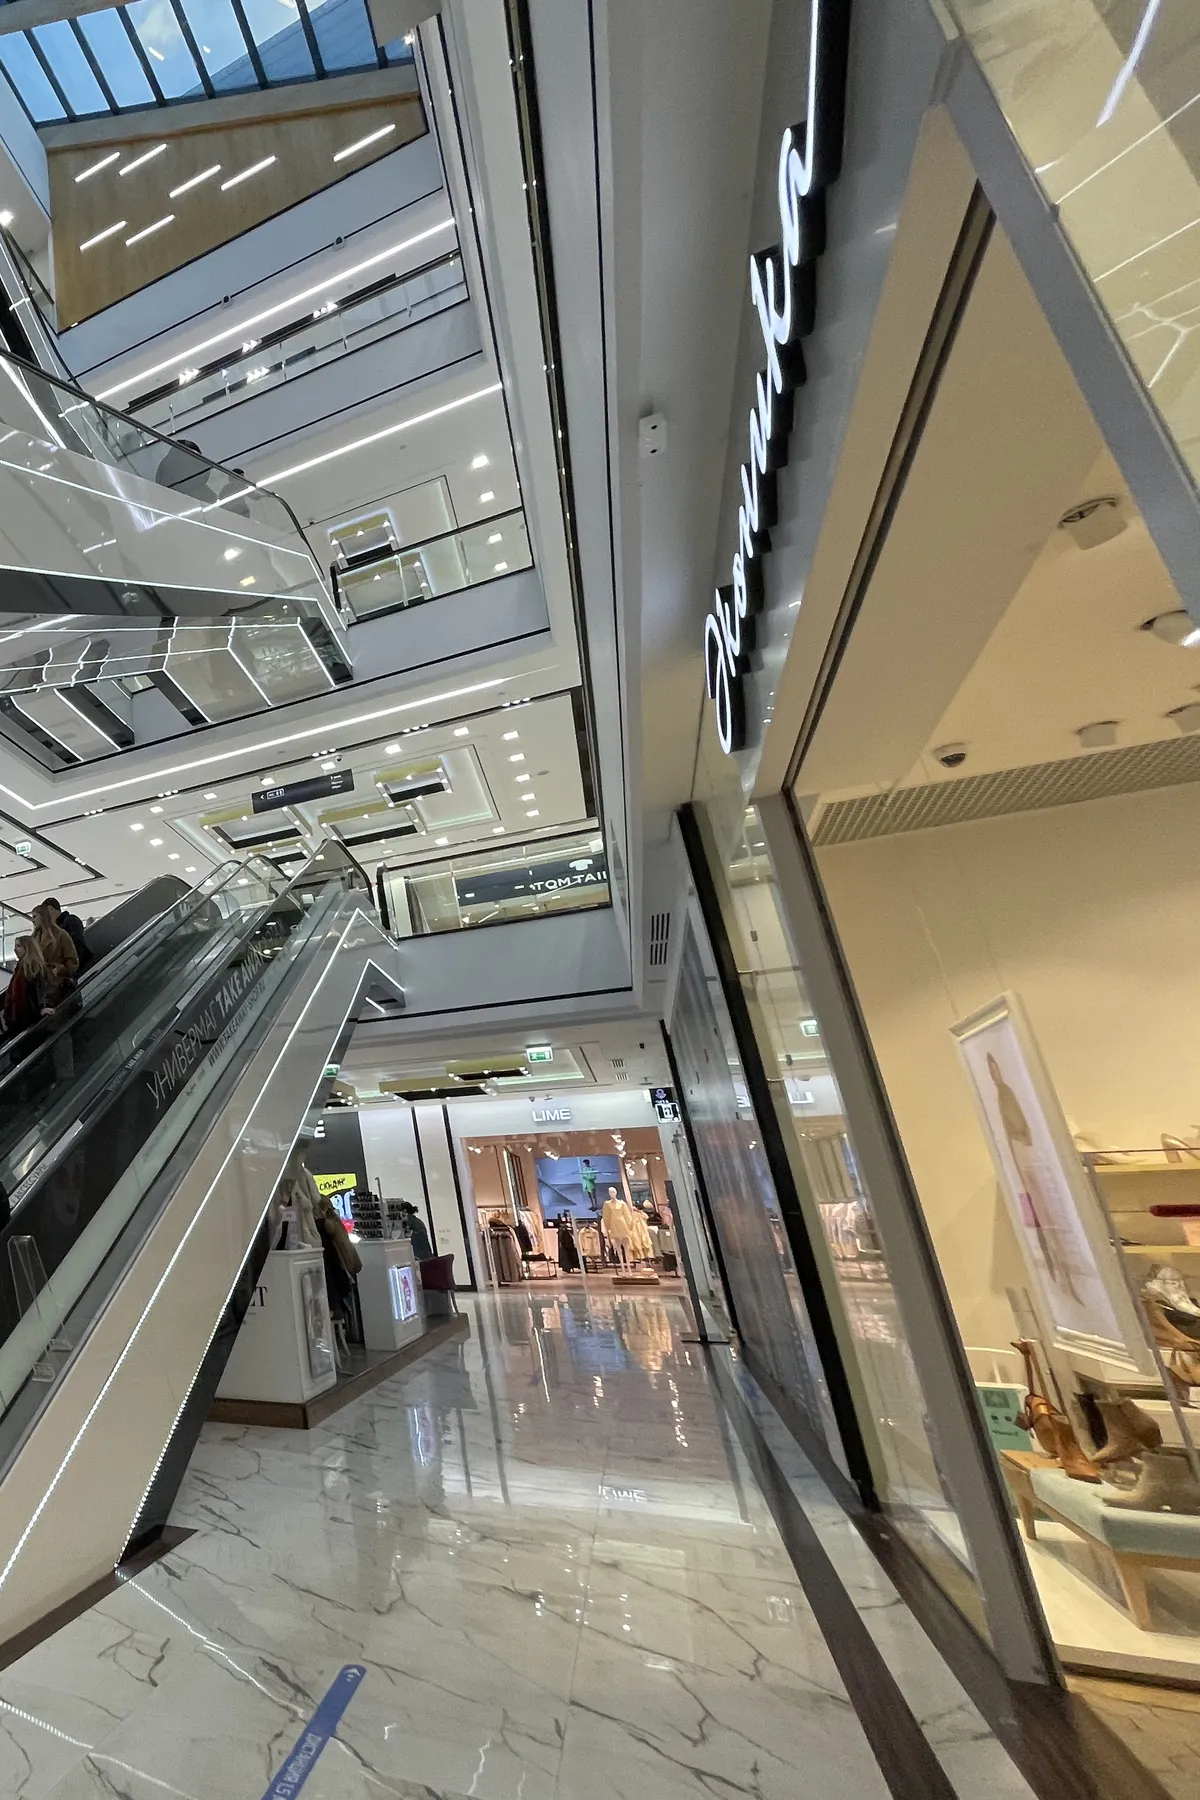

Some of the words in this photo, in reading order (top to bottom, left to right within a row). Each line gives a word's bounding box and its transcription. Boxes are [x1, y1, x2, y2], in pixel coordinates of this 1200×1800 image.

[146, 1001, 218, 1109] УНИВЕРМАГ
[214, 971, 243, 1017] TAKE
[531, 1108, 571, 1123] LIME
